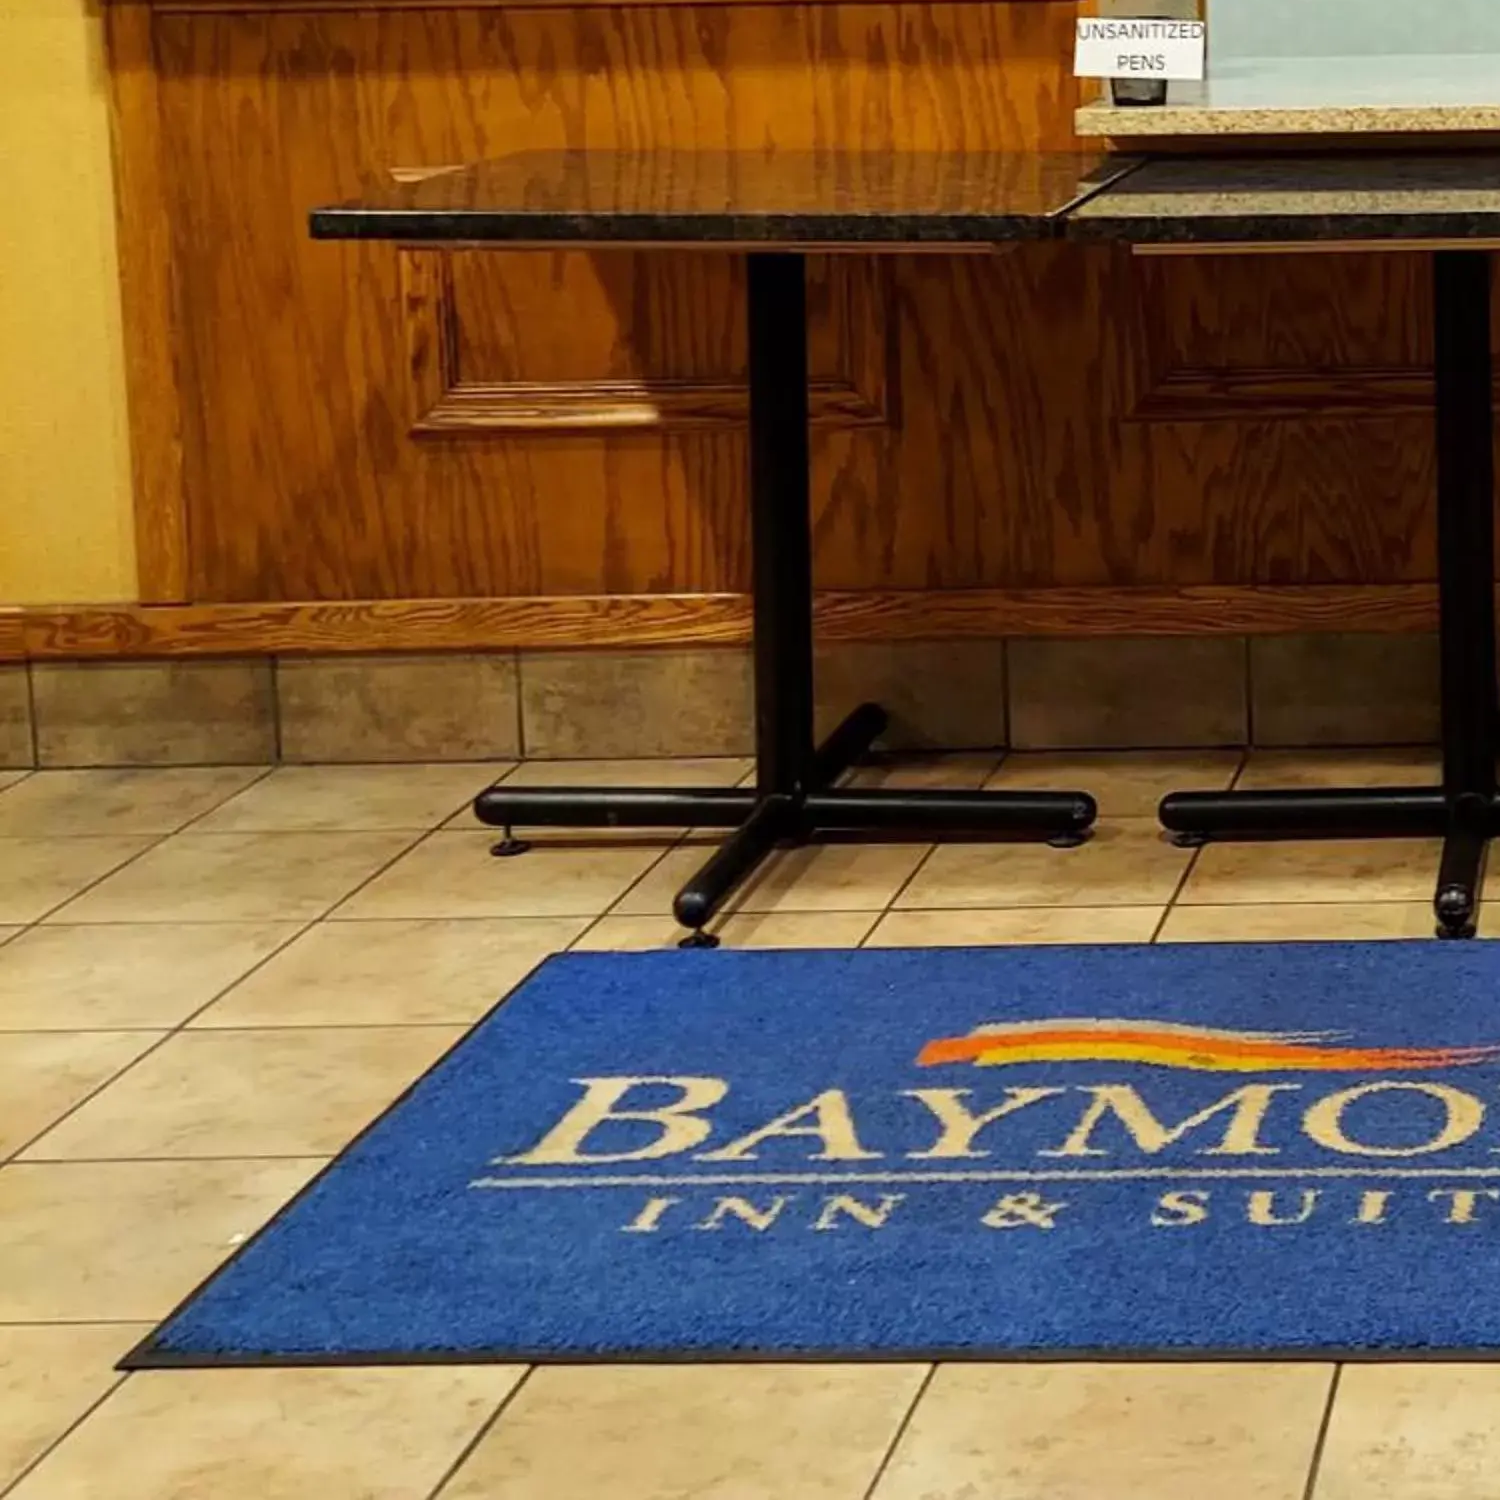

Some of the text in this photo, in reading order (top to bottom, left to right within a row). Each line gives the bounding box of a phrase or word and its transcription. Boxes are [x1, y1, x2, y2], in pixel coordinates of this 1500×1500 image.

[1077, 23, 1204, 41] UNSANITIZED
[1116, 54, 1166, 71] PENS
[620, 1192, 908, 1232] INN
[980, 1191, 1068, 1231] &
